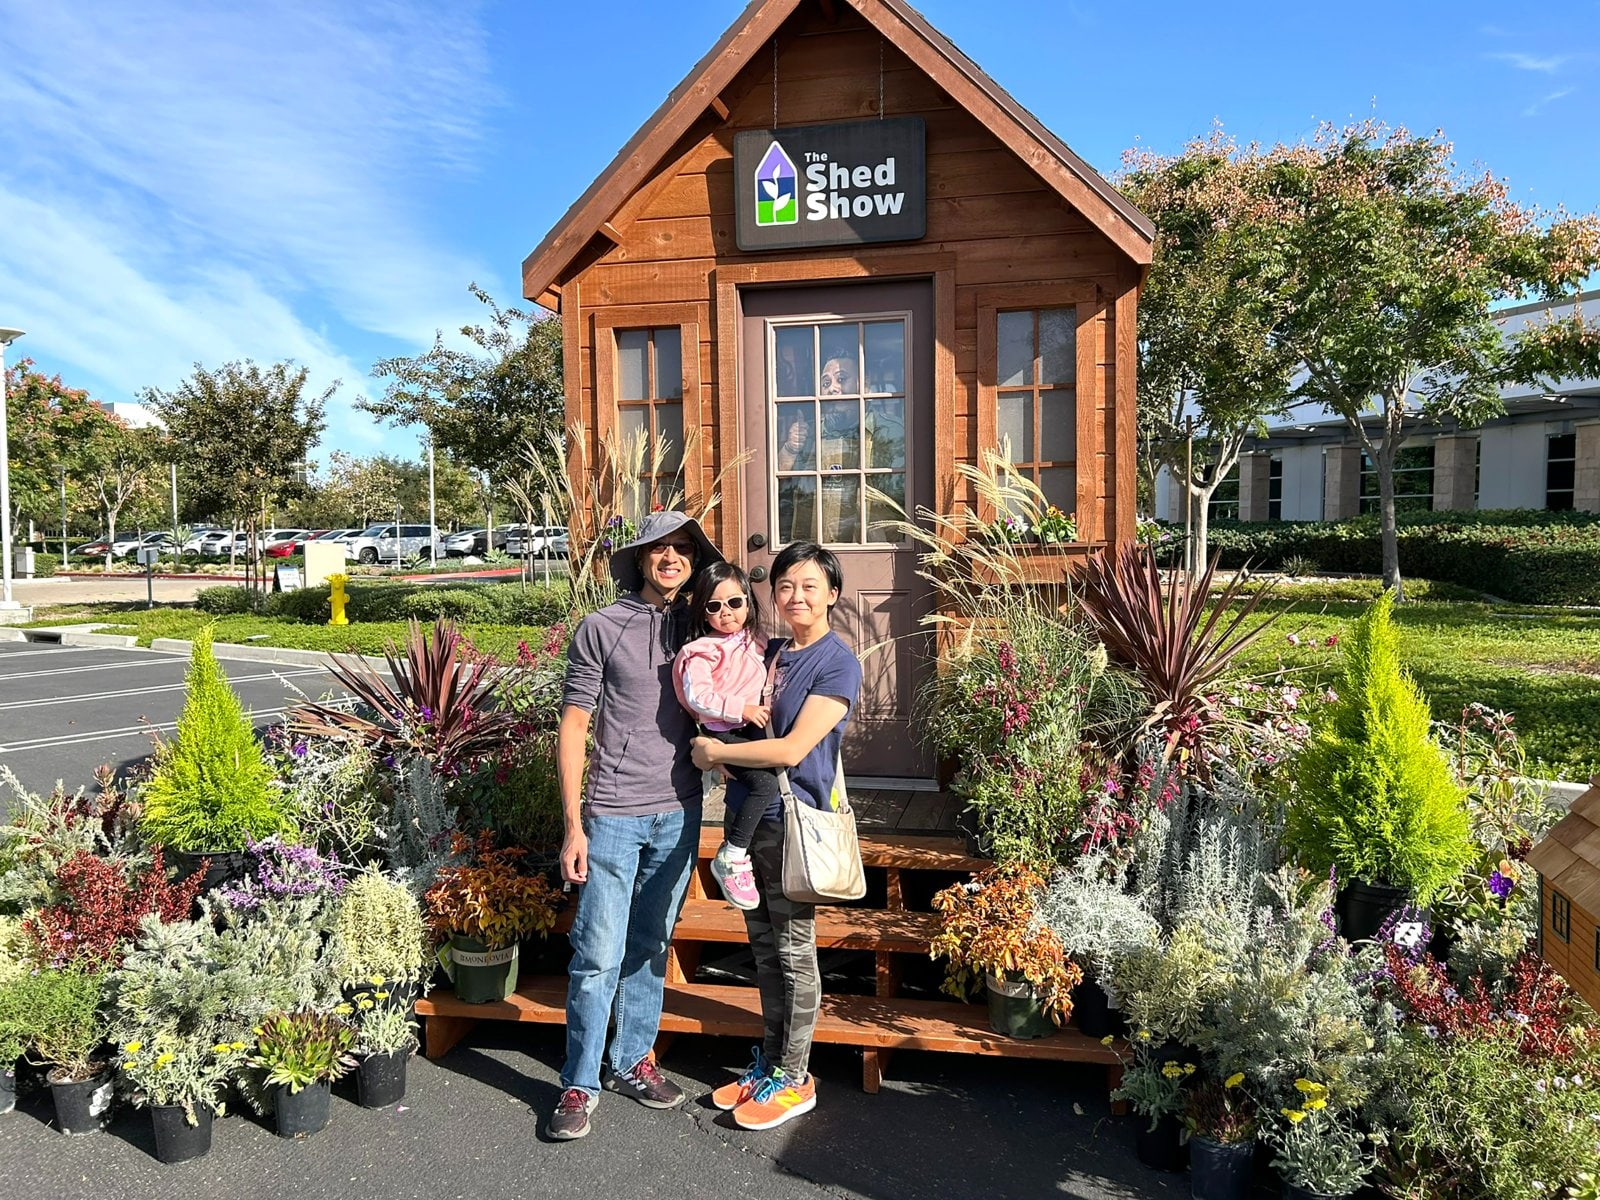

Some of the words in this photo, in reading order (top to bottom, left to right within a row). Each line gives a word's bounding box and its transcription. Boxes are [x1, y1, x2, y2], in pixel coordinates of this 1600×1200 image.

[804, 152, 828, 162] The
[805, 157, 896, 192] Shed
[806, 192, 905, 221] Show
[464, 952, 510, 963] MONOVIA
